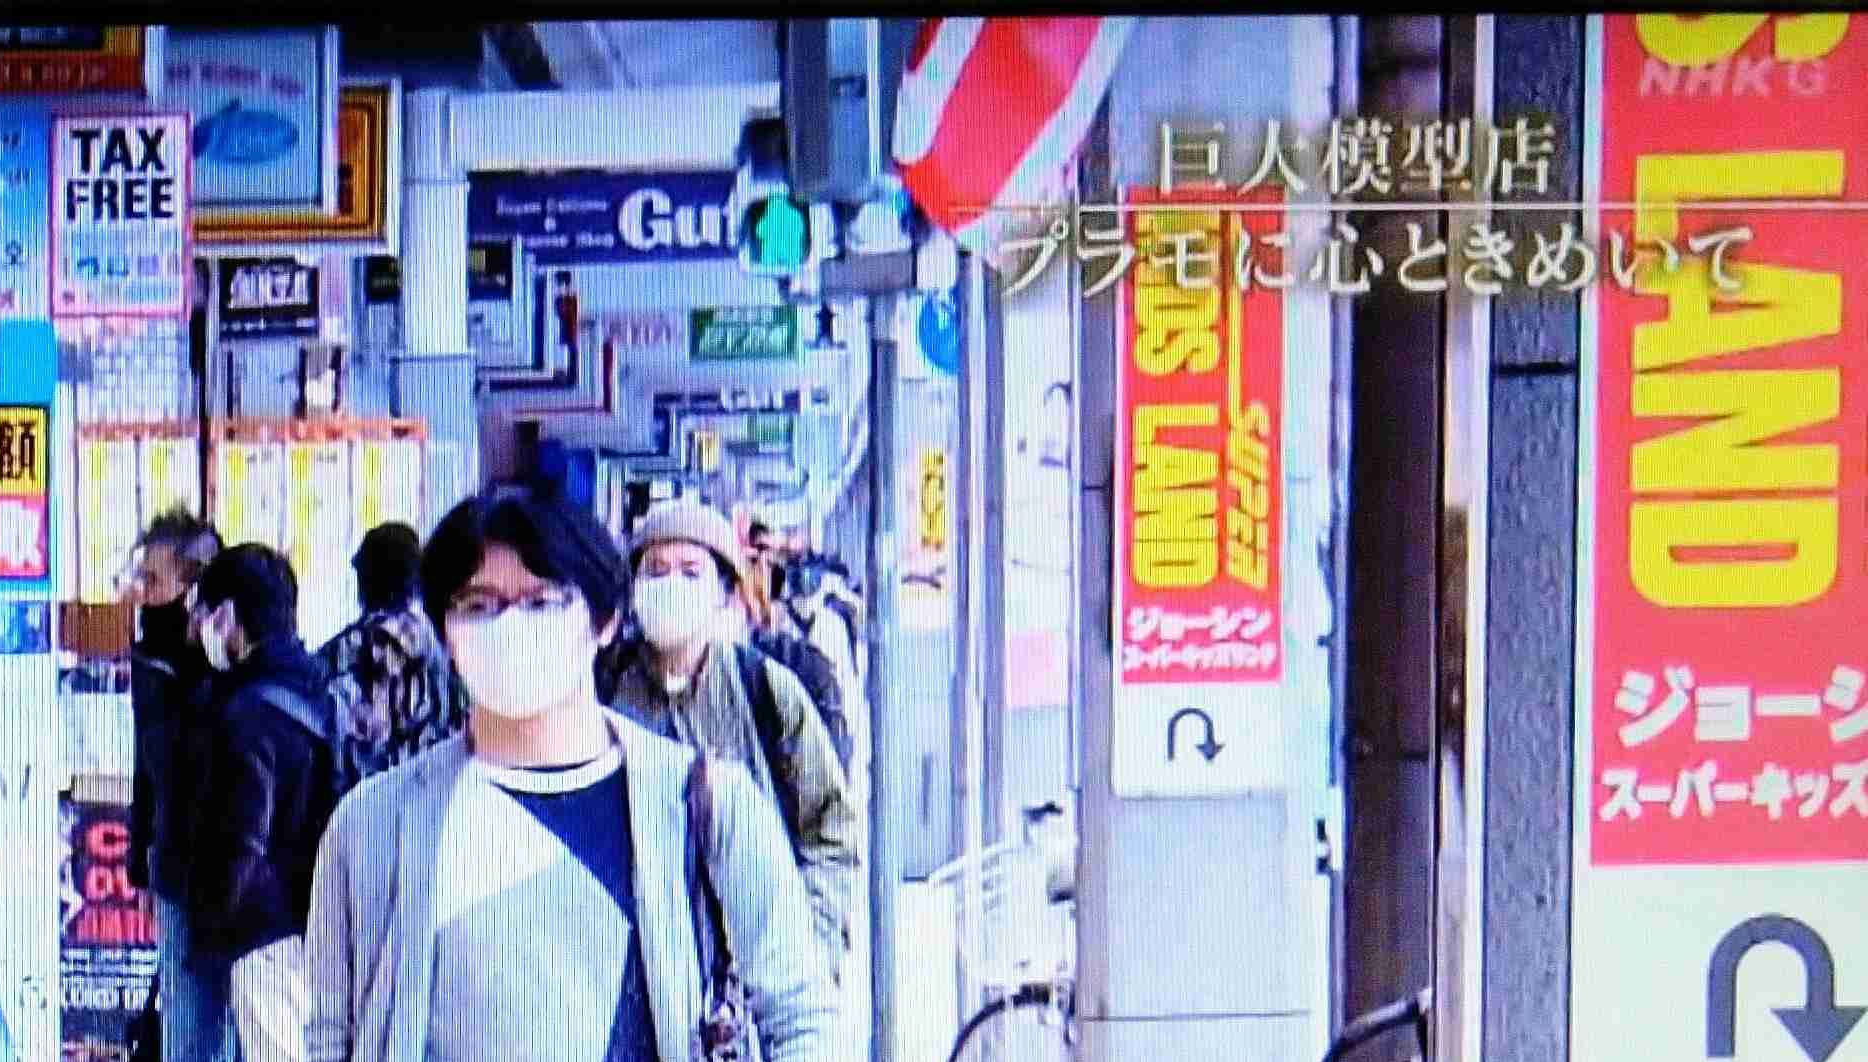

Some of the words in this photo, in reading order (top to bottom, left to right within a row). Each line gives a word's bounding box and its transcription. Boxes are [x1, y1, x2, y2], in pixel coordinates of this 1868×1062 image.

[71, 128, 166, 174] TAX
[66, 177, 175, 222] FREE
[1629, 149, 1846, 608] LAND
[1133, 403, 1221, 589] LAND
[1126, 606, 1272, 642] ジョーシン
[1599, 758, 1868, 821] スーパーキッズ
